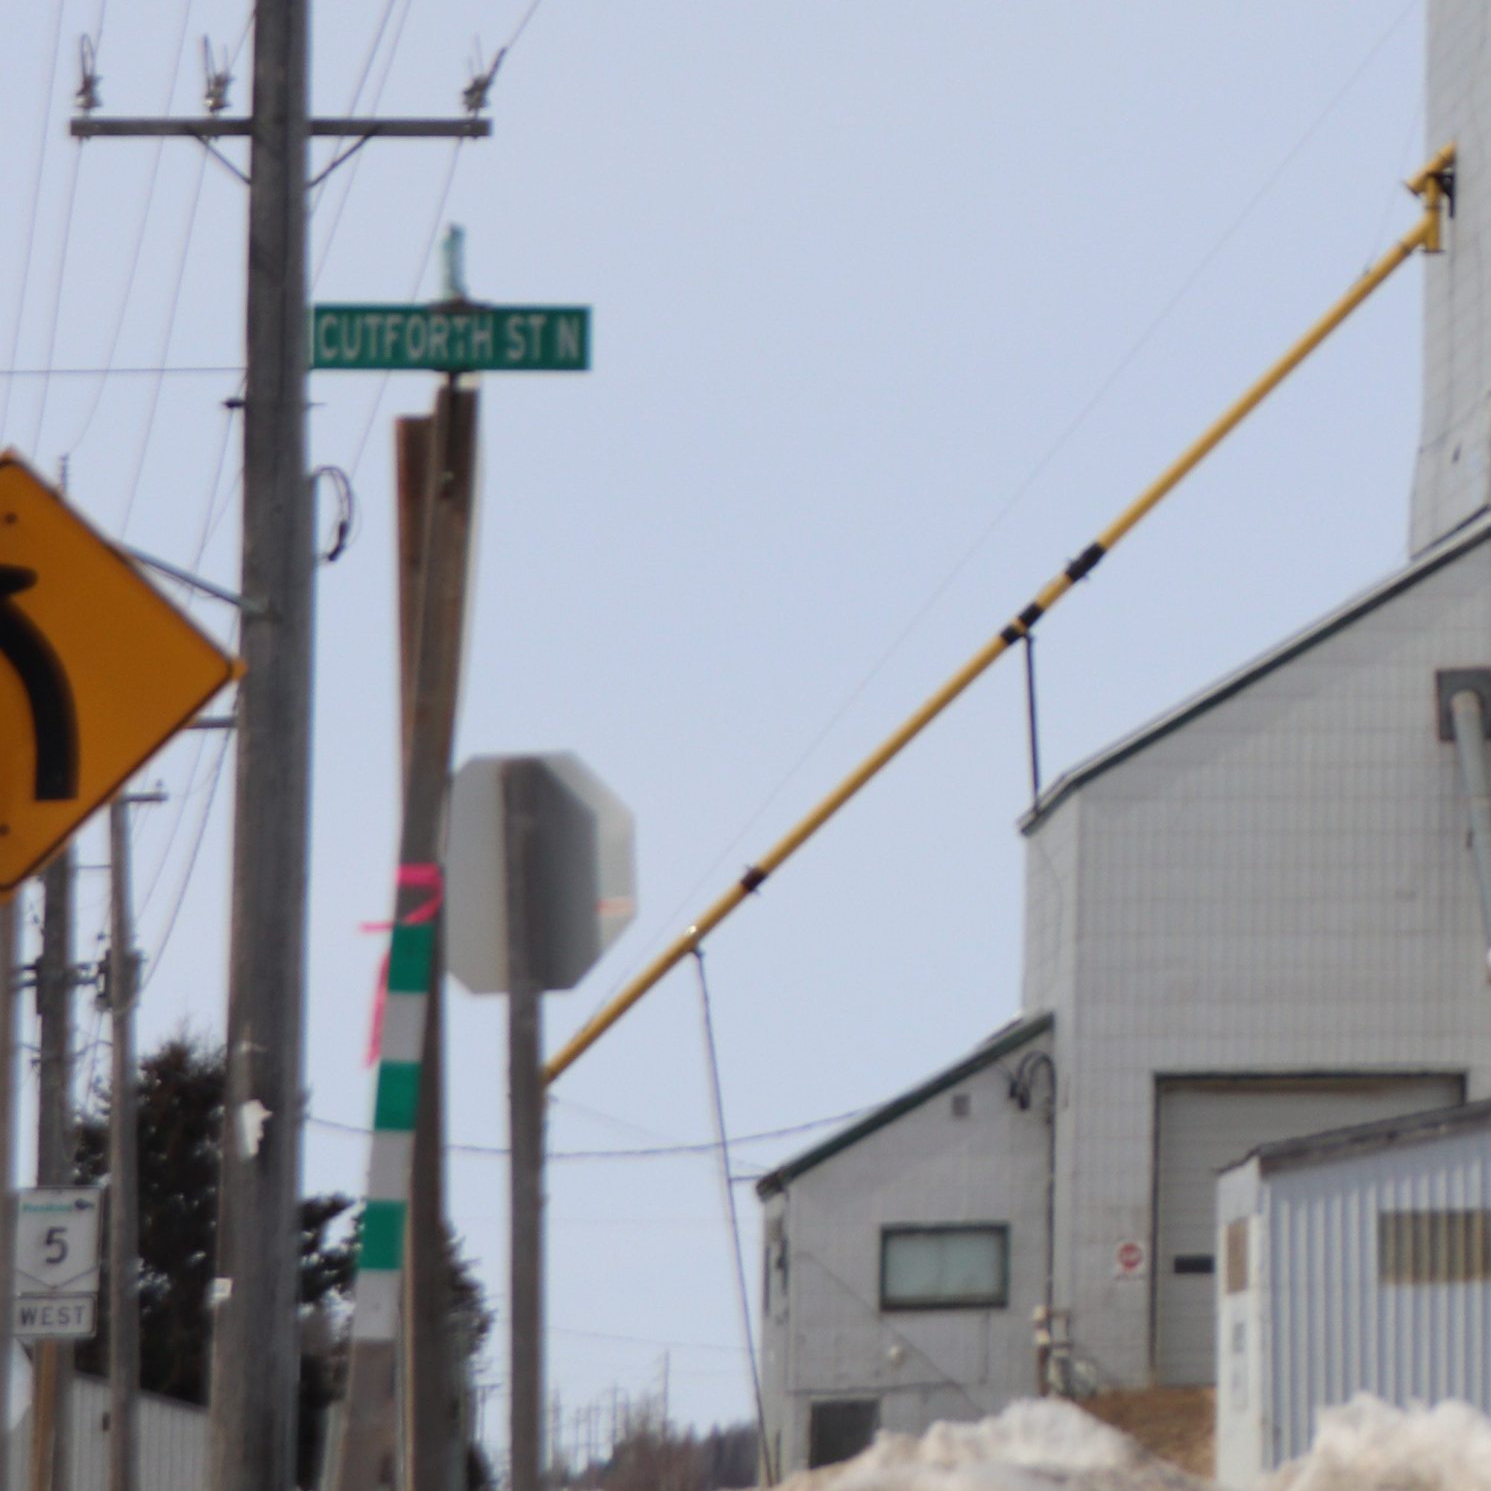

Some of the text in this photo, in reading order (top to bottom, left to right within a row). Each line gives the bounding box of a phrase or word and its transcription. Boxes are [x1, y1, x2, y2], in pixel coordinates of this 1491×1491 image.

[318, 313, 580, 360] CUTFORTH ST N
[45, 1226, 69, 1264] 5
[20, 1306, 86, 1326] WEST
